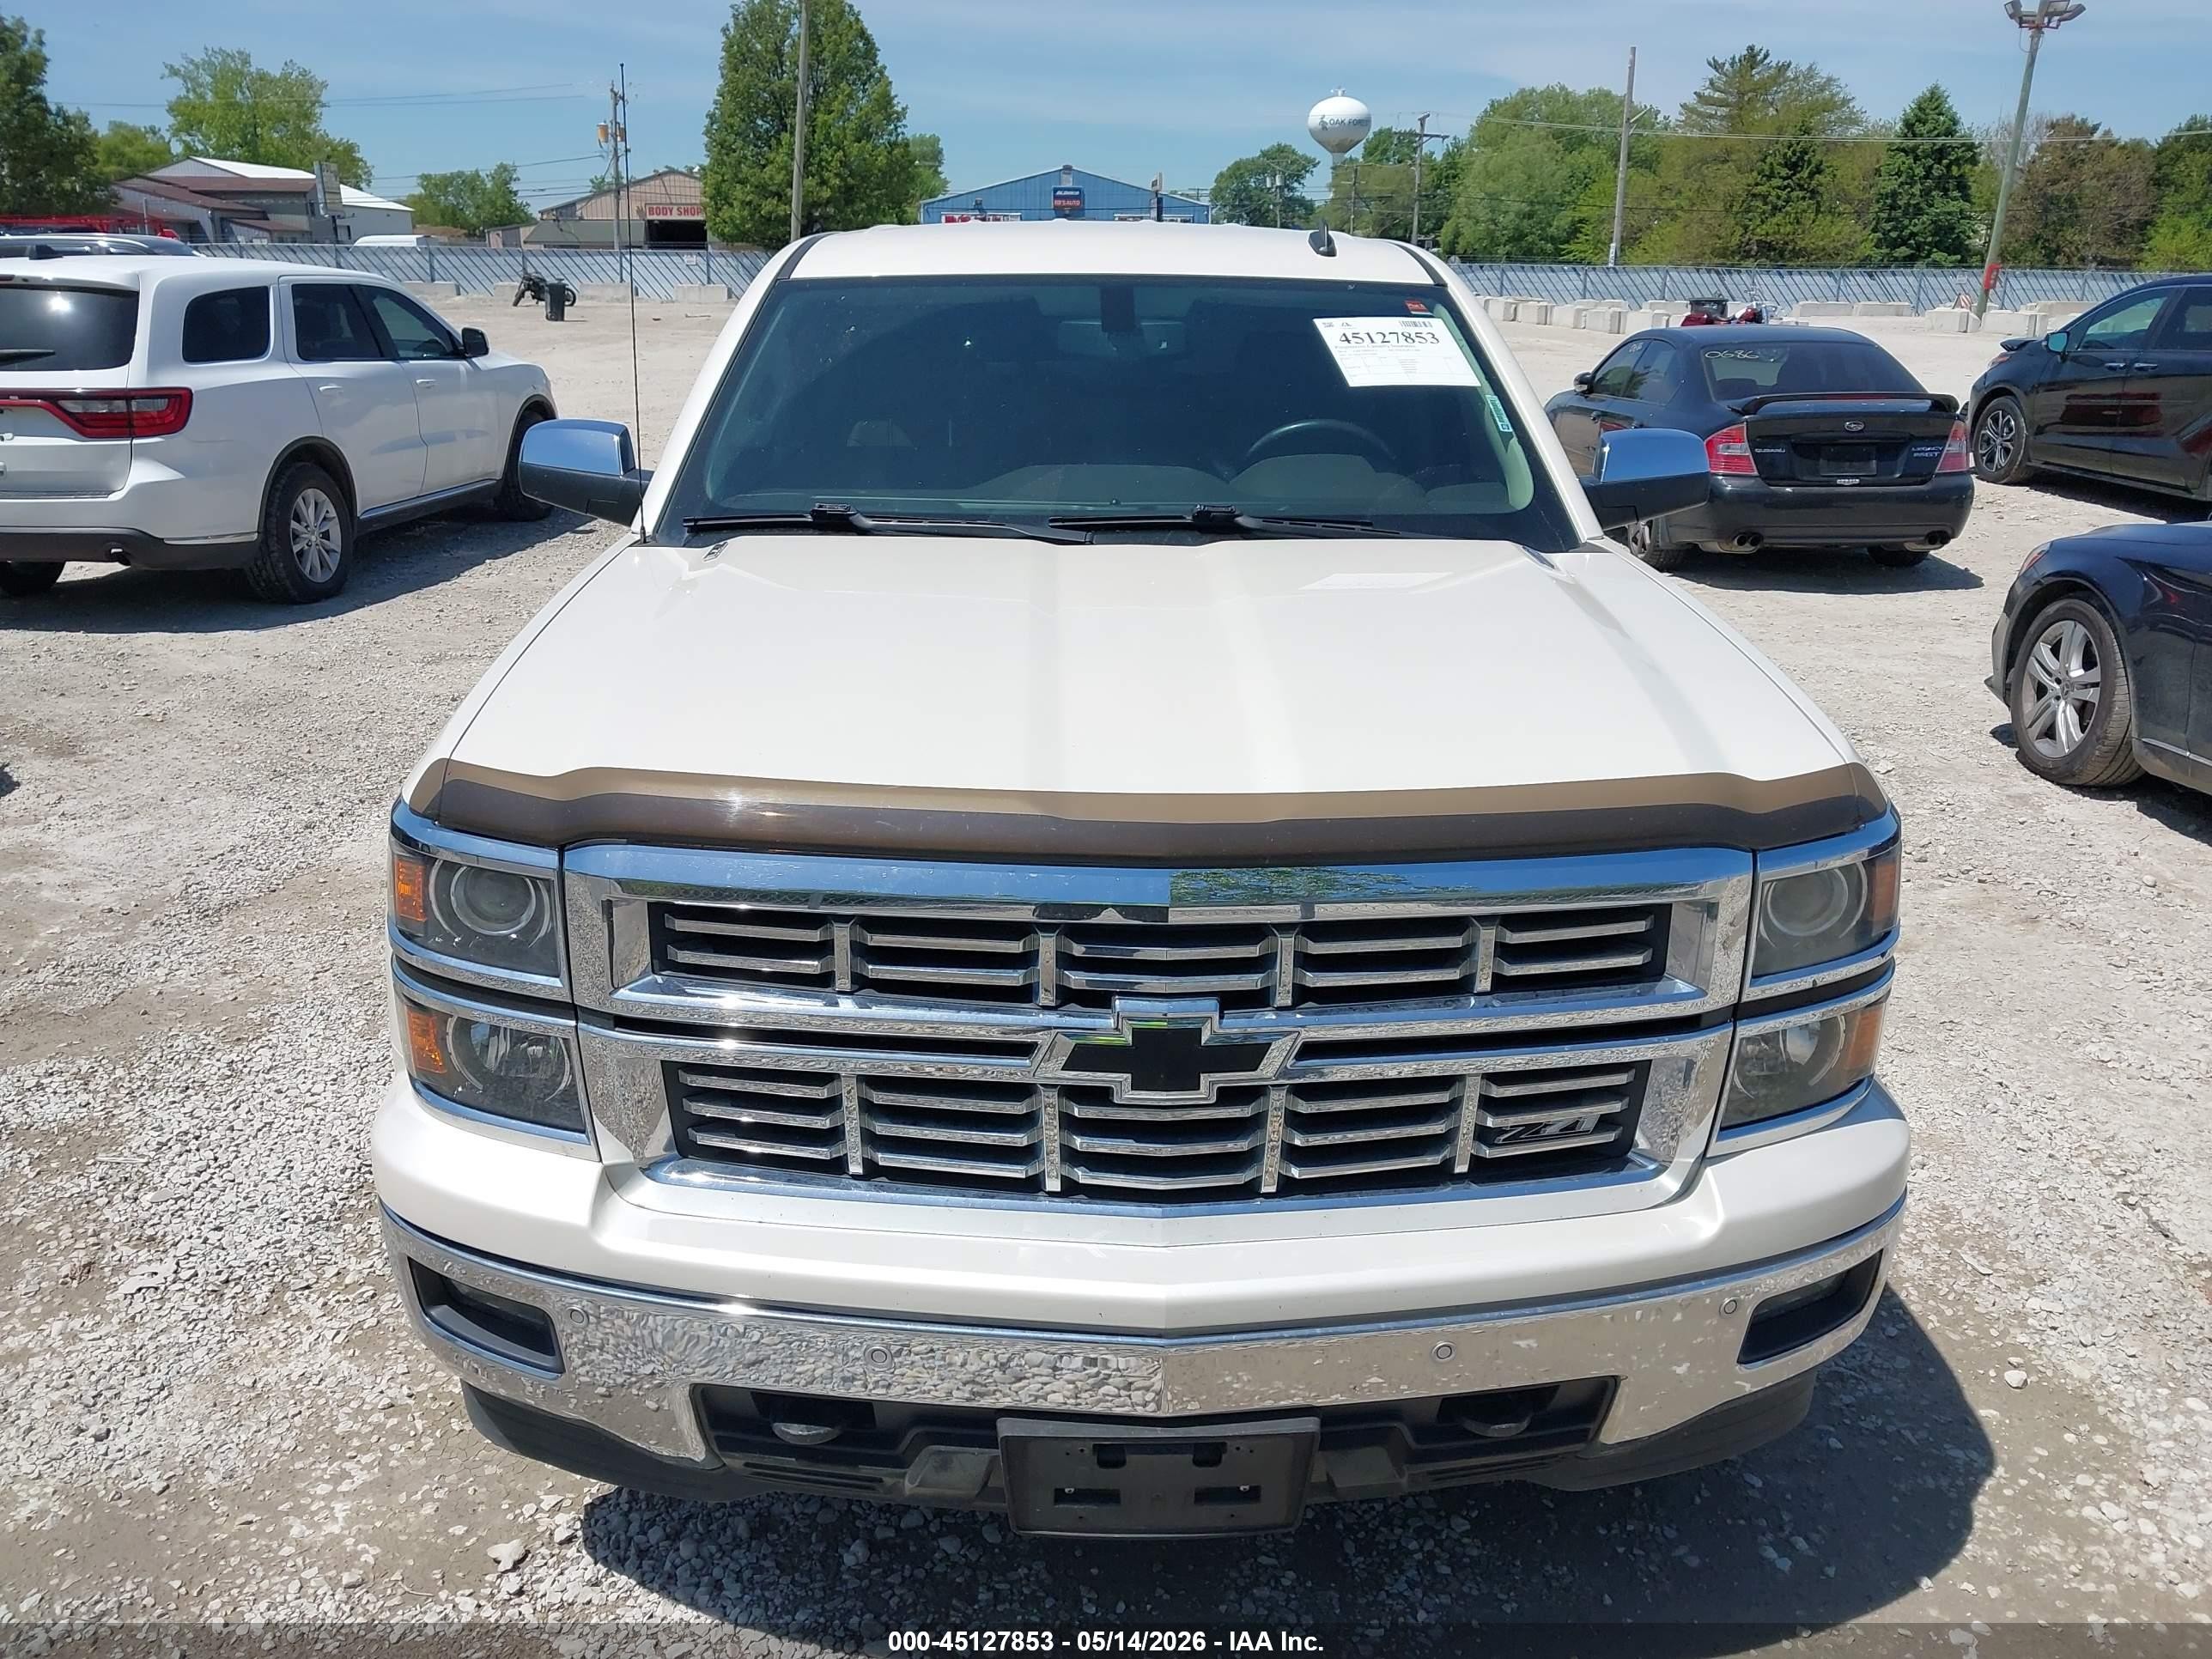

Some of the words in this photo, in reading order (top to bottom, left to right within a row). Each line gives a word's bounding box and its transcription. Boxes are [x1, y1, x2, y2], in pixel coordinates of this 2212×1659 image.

[648, 206, 673, 216] BODY
[677, 206, 702, 216] SHOP
[1340, 331, 1440, 344] 45127853
[1705, 349, 1759, 359] 0686
[1494, 1115, 1601, 1144] Z71
